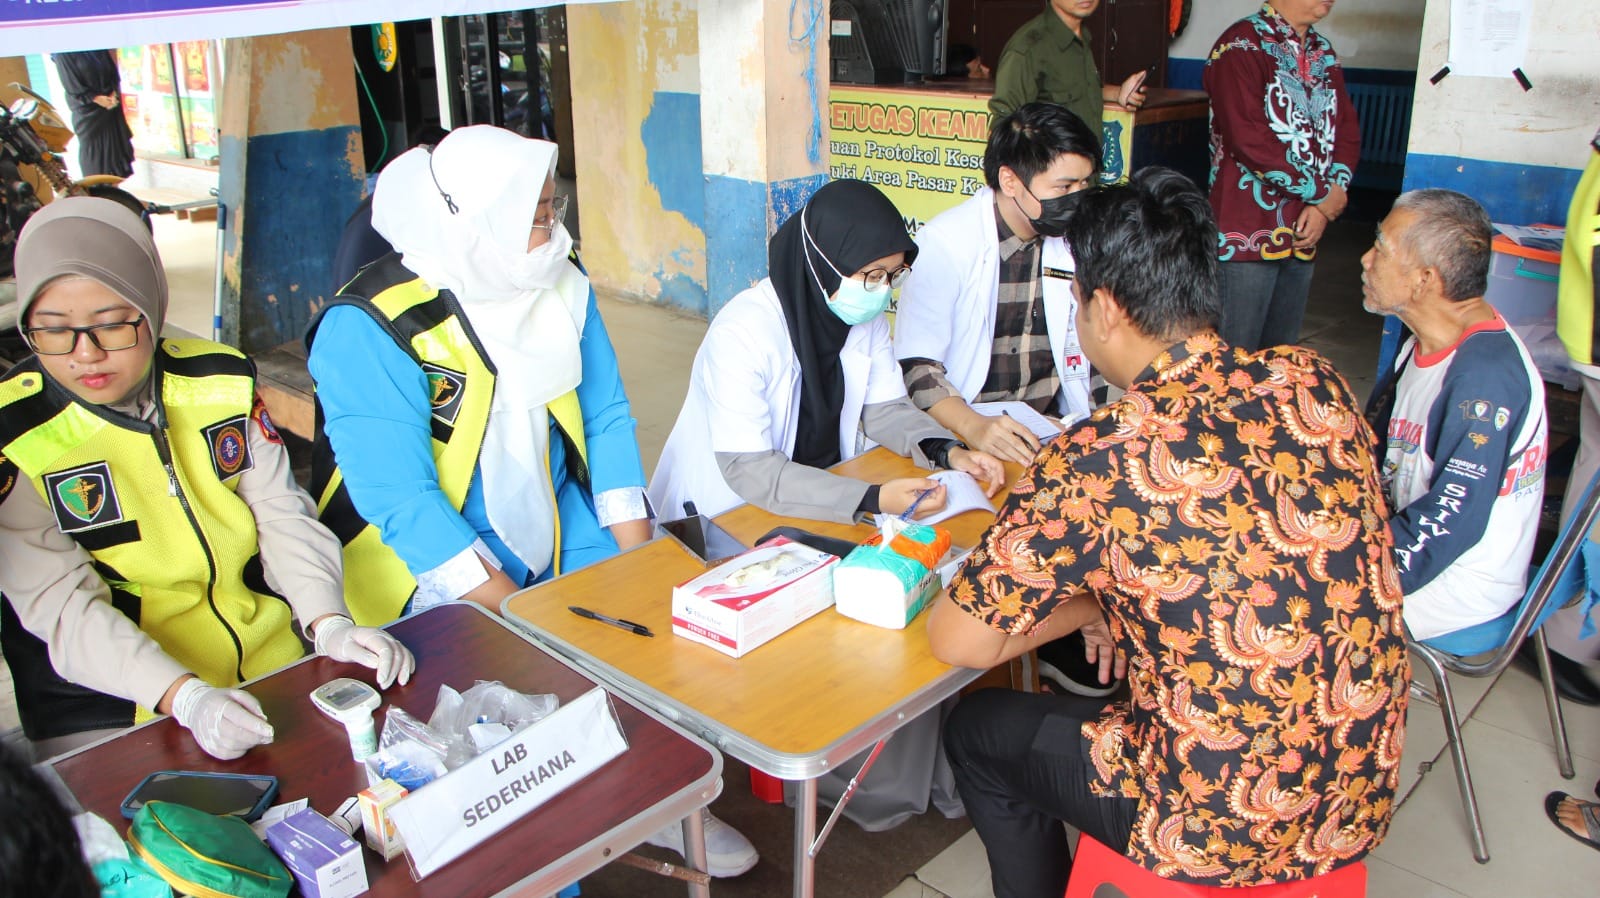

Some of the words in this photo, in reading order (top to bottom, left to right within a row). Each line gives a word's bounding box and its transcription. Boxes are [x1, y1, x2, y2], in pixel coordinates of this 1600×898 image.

[830, 101, 915, 136] ETUGAS
[918, 107, 992, 143] KEAM
[865, 140, 940, 165] Protokol
[862, 166, 902, 187] Area
[906, 170, 957, 193] Pasar
[491, 743, 528, 775] LAB
[463, 749, 576, 828] SEDERHANA
